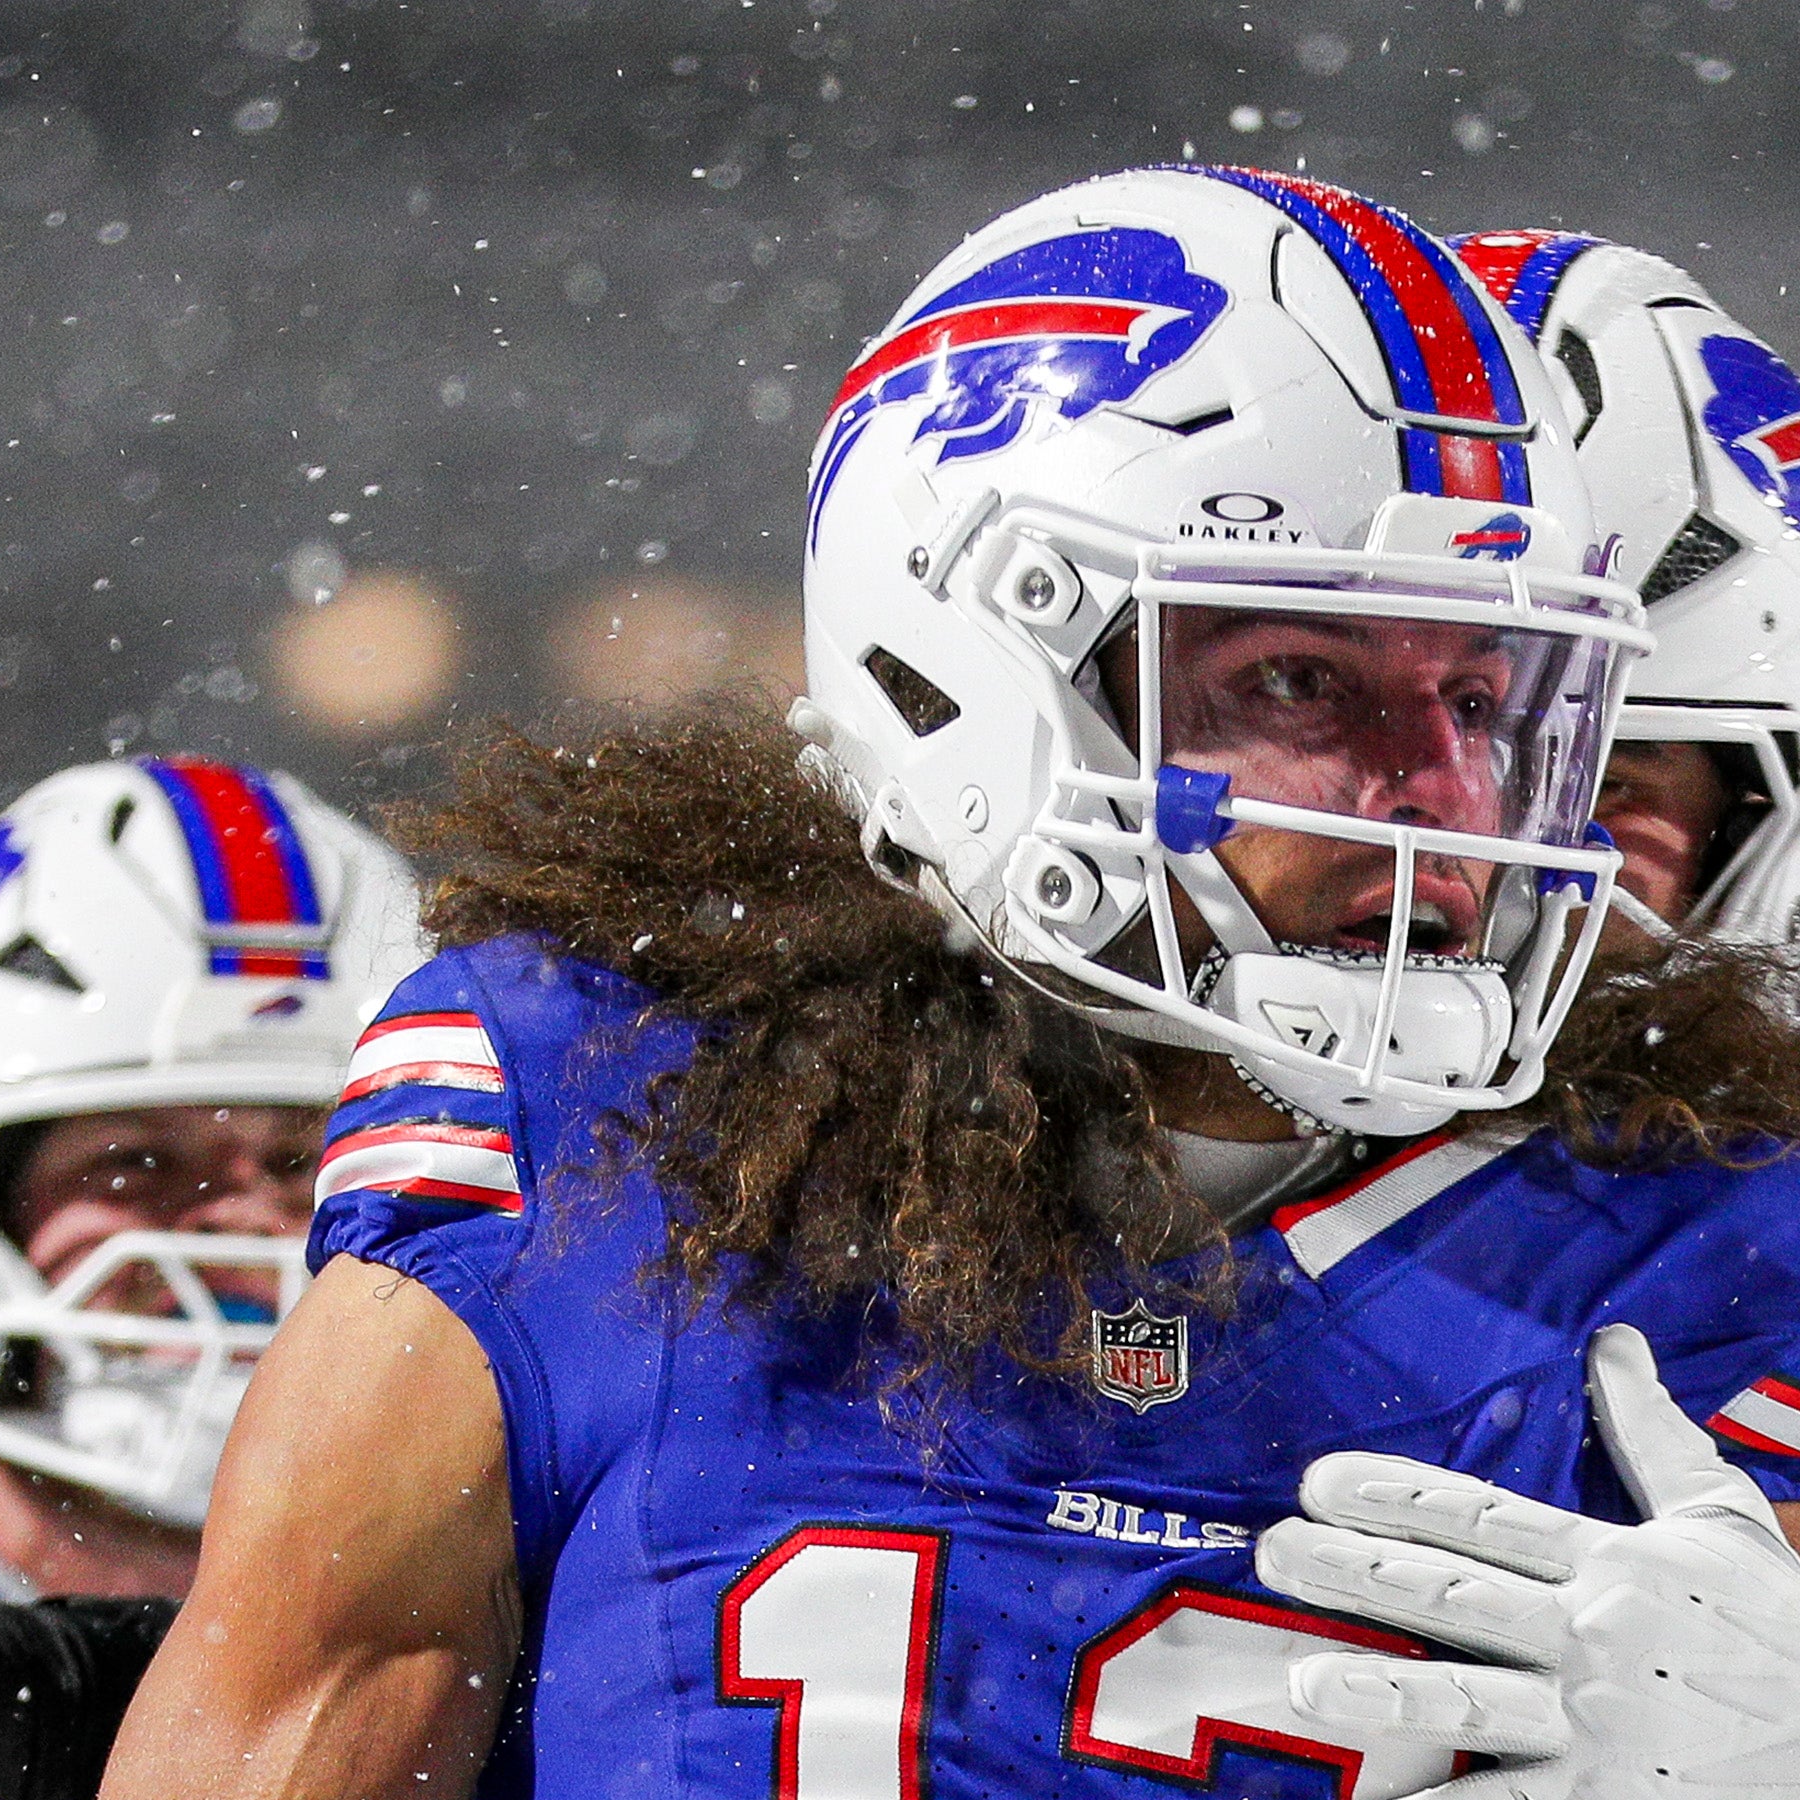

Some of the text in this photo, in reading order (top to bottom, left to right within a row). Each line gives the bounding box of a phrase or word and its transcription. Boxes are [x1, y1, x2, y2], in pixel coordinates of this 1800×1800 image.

[1179, 522, 1302, 545] OAKLEY
[1106, 1348, 1175, 1390] NFL
[1046, 1490, 1251, 1549] BILLS
